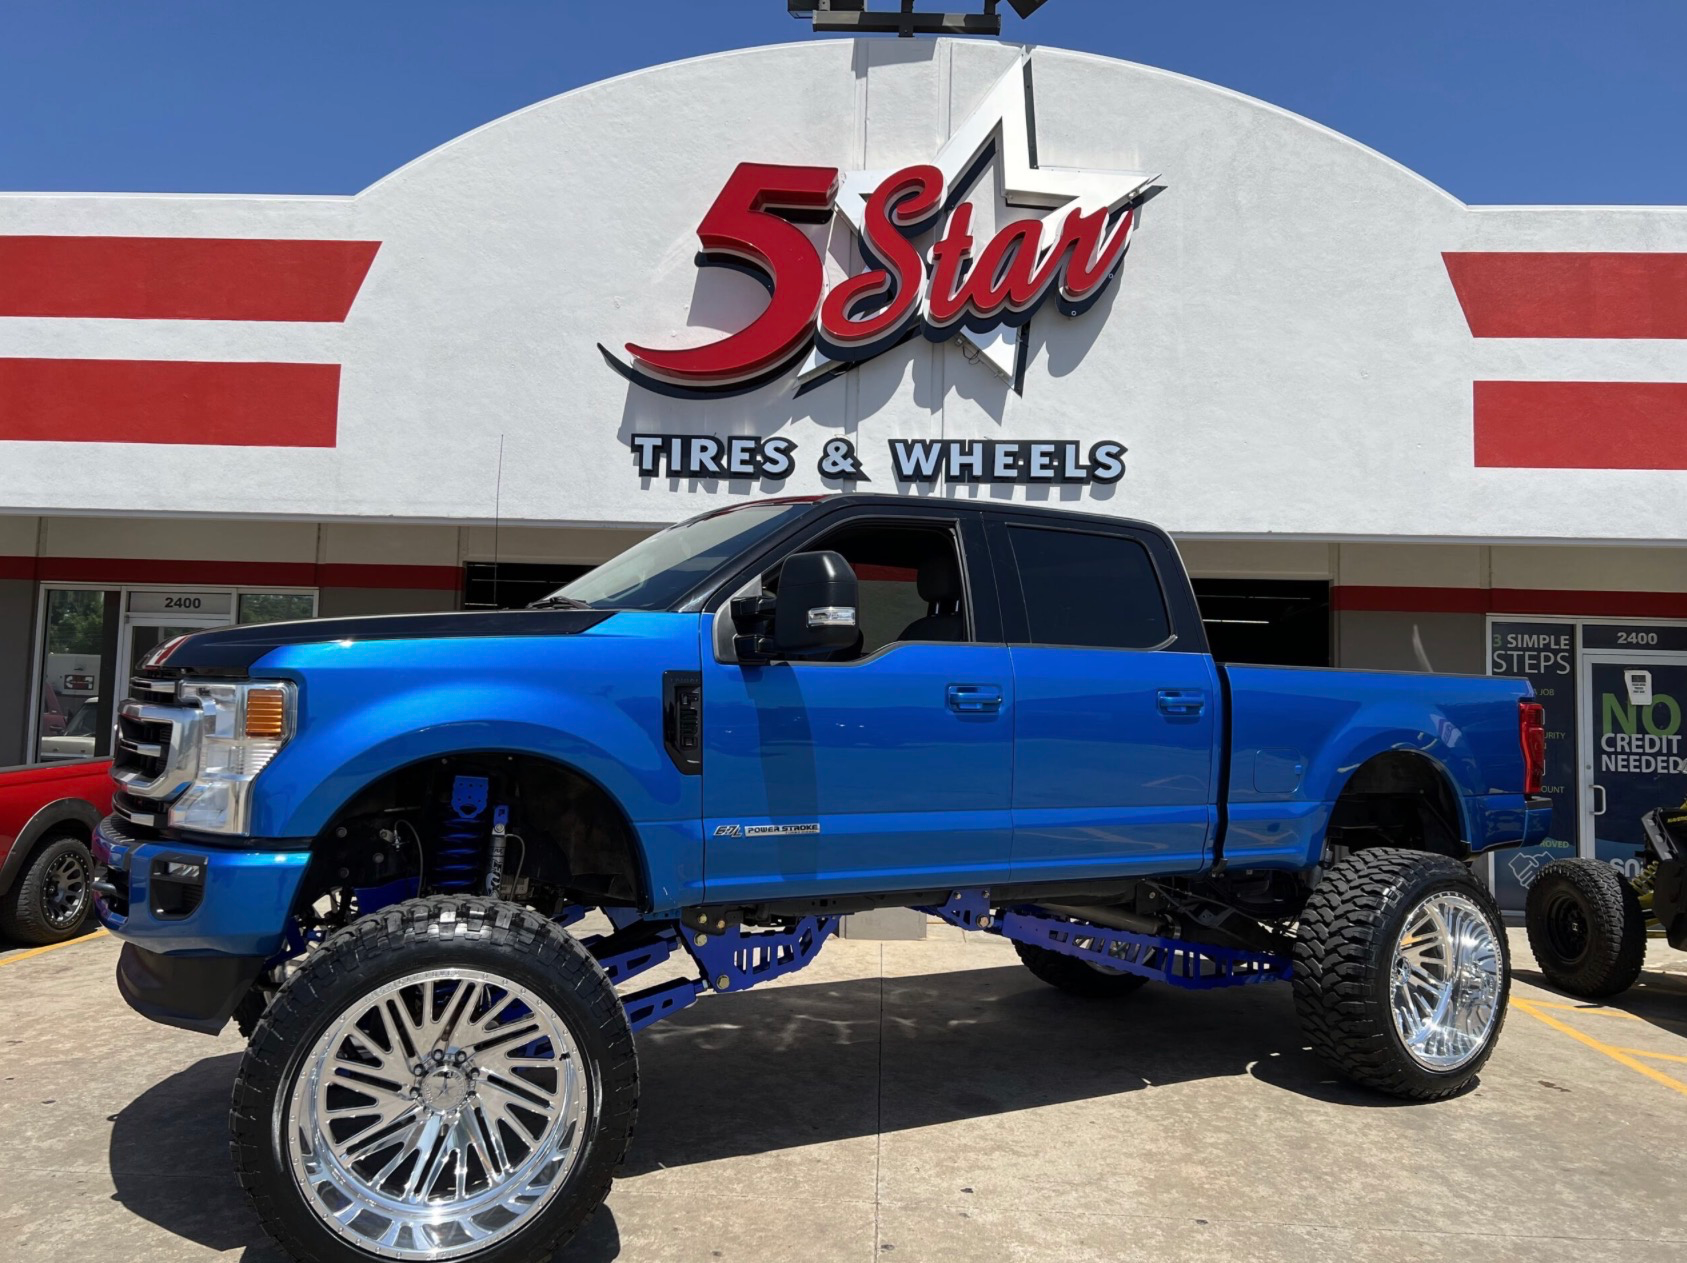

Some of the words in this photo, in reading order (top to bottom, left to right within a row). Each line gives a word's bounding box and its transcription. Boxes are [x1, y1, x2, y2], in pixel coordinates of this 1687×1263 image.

[620, 161, 841, 380] 5
[820, 164, 1135, 348] Star
[633, 436, 793, 476] TIRES
[823, 438, 863, 476] &
[893, 441, 1126, 480] WHEELS
[164, 597, 202, 609] 2400
[1493, 634, 1502, 647] 3
[1507, 633, 1570, 649] SIMPLE
[1616, 631, 1658, 645] 2400
[1493, 650, 1571, 675] STEPS
[1539, 688, 1555, 696] JOB
[1602, 692, 1681, 737] NO
[1600, 733, 1682, 754] CREDIT
[748, 825, 780, 834] POWER
[782, 823, 818, 832] STROKE
